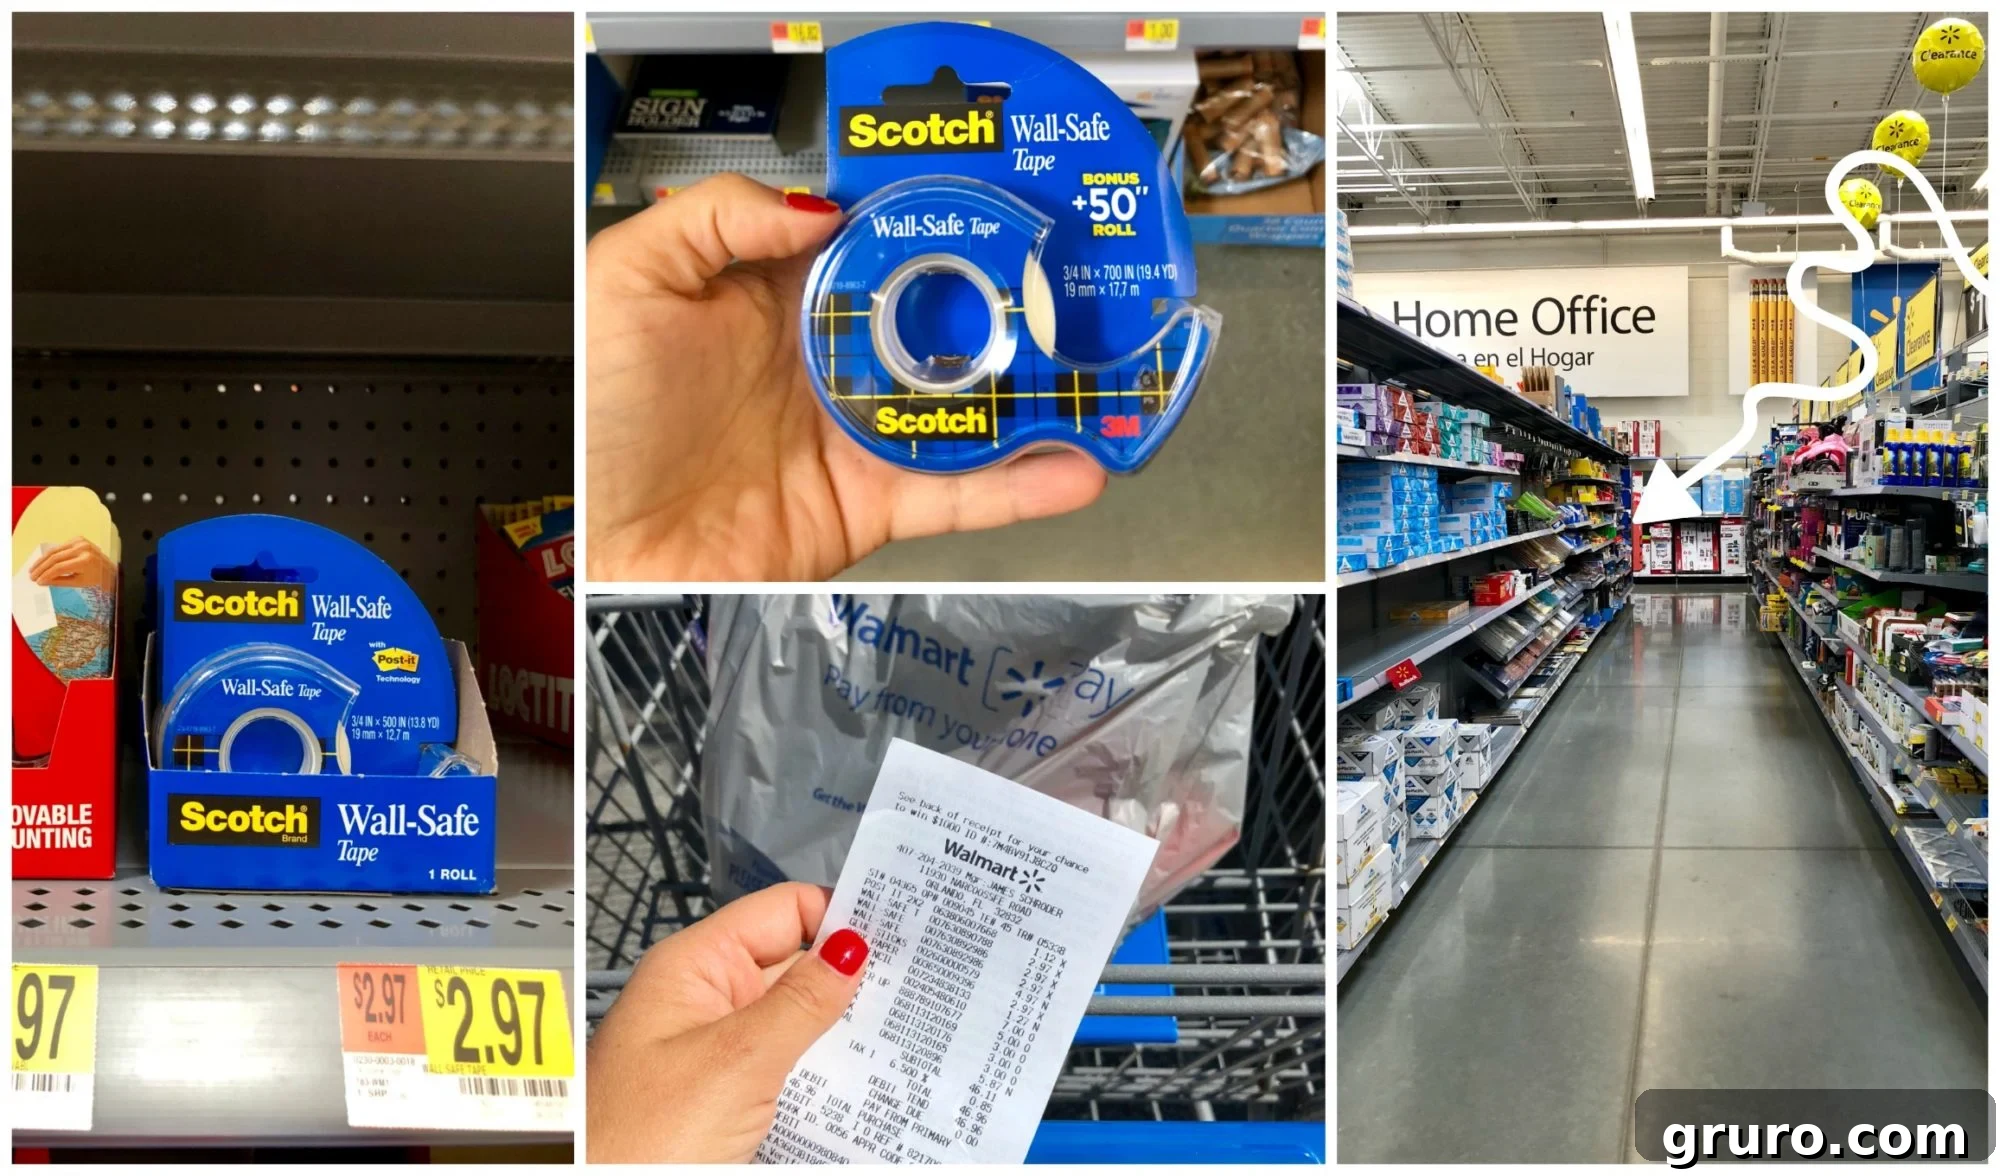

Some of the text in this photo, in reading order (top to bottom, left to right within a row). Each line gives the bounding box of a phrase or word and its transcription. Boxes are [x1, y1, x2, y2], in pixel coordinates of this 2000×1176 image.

[1920, 49, 1977, 62] Clearance
[630, 97, 708, 117] SIGN
[627, 114, 700, 128] HOLDER
[848, 110, 995, 148] Scotch
[1010, 112, 1111, 142] Wall-Safe
[1012, 148, 1055, 176] Tape
[1082, 173, 1140, 185] BONUS
[872, 213, 1000, 239] Wall-Safe Tape
[1093, 223, 1136, 236] ROLL
[1063, 263, 1178, 282] 3/4 IN 700 IN (19.4 YD)
[1064, 282, 1076, 298] 19
[1078, 284, 1096, 297] mm
[1130, 284, 1140, 297] m
[1393, 294, 1656, 338] Home Office
[1907, 330, 1931, 356] Clearance
[1474, 351, 1499, 367] en
[1506, 347, 1524, 367] el
[1531, 347, 1595, 371] Hogar
[876, 406, 987, 434] Scotch
[1100, 415, 1142, 438] 3M
[180, 587, 299, 617] Scotch
[311, 594, 392, 620] Wall-Safe
[312, 622, 347, 645] Tape
[368, 641, 387, 649] with
[377, 655, 417, 665] Post-it
[221, 678, 322, 701] Wall-Safe Tape
[375, 674, 421, 684] Technology
[873, 685, 937, 727] from
[351, 715, 440, 730] 3/4 IN 500 IN (13.8 YD)
[352, 728, 410, 742] 19 mm 12,7 m
[180, 801, 308, 833] Scotch
[336, 803, 480, 837] Wall-Safe
[894, 802, 977, 840] to win $1000 ID
[282, 834, 308, 843] Brand
[897, 791, 1089, 874] See back of receipt for your chance
[337, 840, 378, 866] Tape
[944, 838, 1018, 881] Walmart
[428, 869, 477, 880] 1 ROLL
[919, 864, 947, 882] 11930
[1008, 900, 1032, 917] ROAD
[971, 897, 983, 909] FL
[993, 906, 1022, 925] 32832
[874, 927, 907, 947] STICKS
[1014, 989, 1038, 1005] 4.97
[1027, 957, 1052, 973] 2.97
[1033, 947, 1056, 963] 1.12
[870, 937, 899, 955] PAPER
[1009, 999, 1034, 1016] 2.97
[1018, 978, 1043, 995] 2.97
[1023, 967, 1048, 984] 2.97
[353, 971, 406, 1024] $2.97
[15, 972, 76, 1060] 97
[434, 976, 546, 1066] $2.97
[1006, 1010, 1029, 1026] 1.27
[367, 1030, 392, 1042] EACH
[996, 1030, 1020, 1048] 5.00
[1002, 1019, 1025, 1037] 7.00
[987, 1052, 1011, 1069] 3.00
[991, 1041, 1016, 1058] 3.00
[446, 1064, 465, 1075] SAFE
[467, 1065, 487, 1075] TAPE
[798, 1068, 827, 1087] DEBIT
[848, 1039, 992, 1113] TAX 6.500 0.85
[899, 1050, 996, 1102] SUBTOTAL 46.11
[983, 1063, 1007, 1080] 3.00
[978, 1073, 1002, 1090] 5.87
[867, 1074, 983, 1136] DEBIT TEND 46.96
[906, 1078, 987, 1124] TOTAL 46.96
[819, 1104, 844, 1123] 5238
[857, 1109, 903, 1138] PURCHASE
[862, 1098, 952, 1147] PAY FROM PRIMARY
[868, 1088, 978, 1147] CHANGE DUE 0.00
[824, 1121, 876, 1154] 0056 APPR
